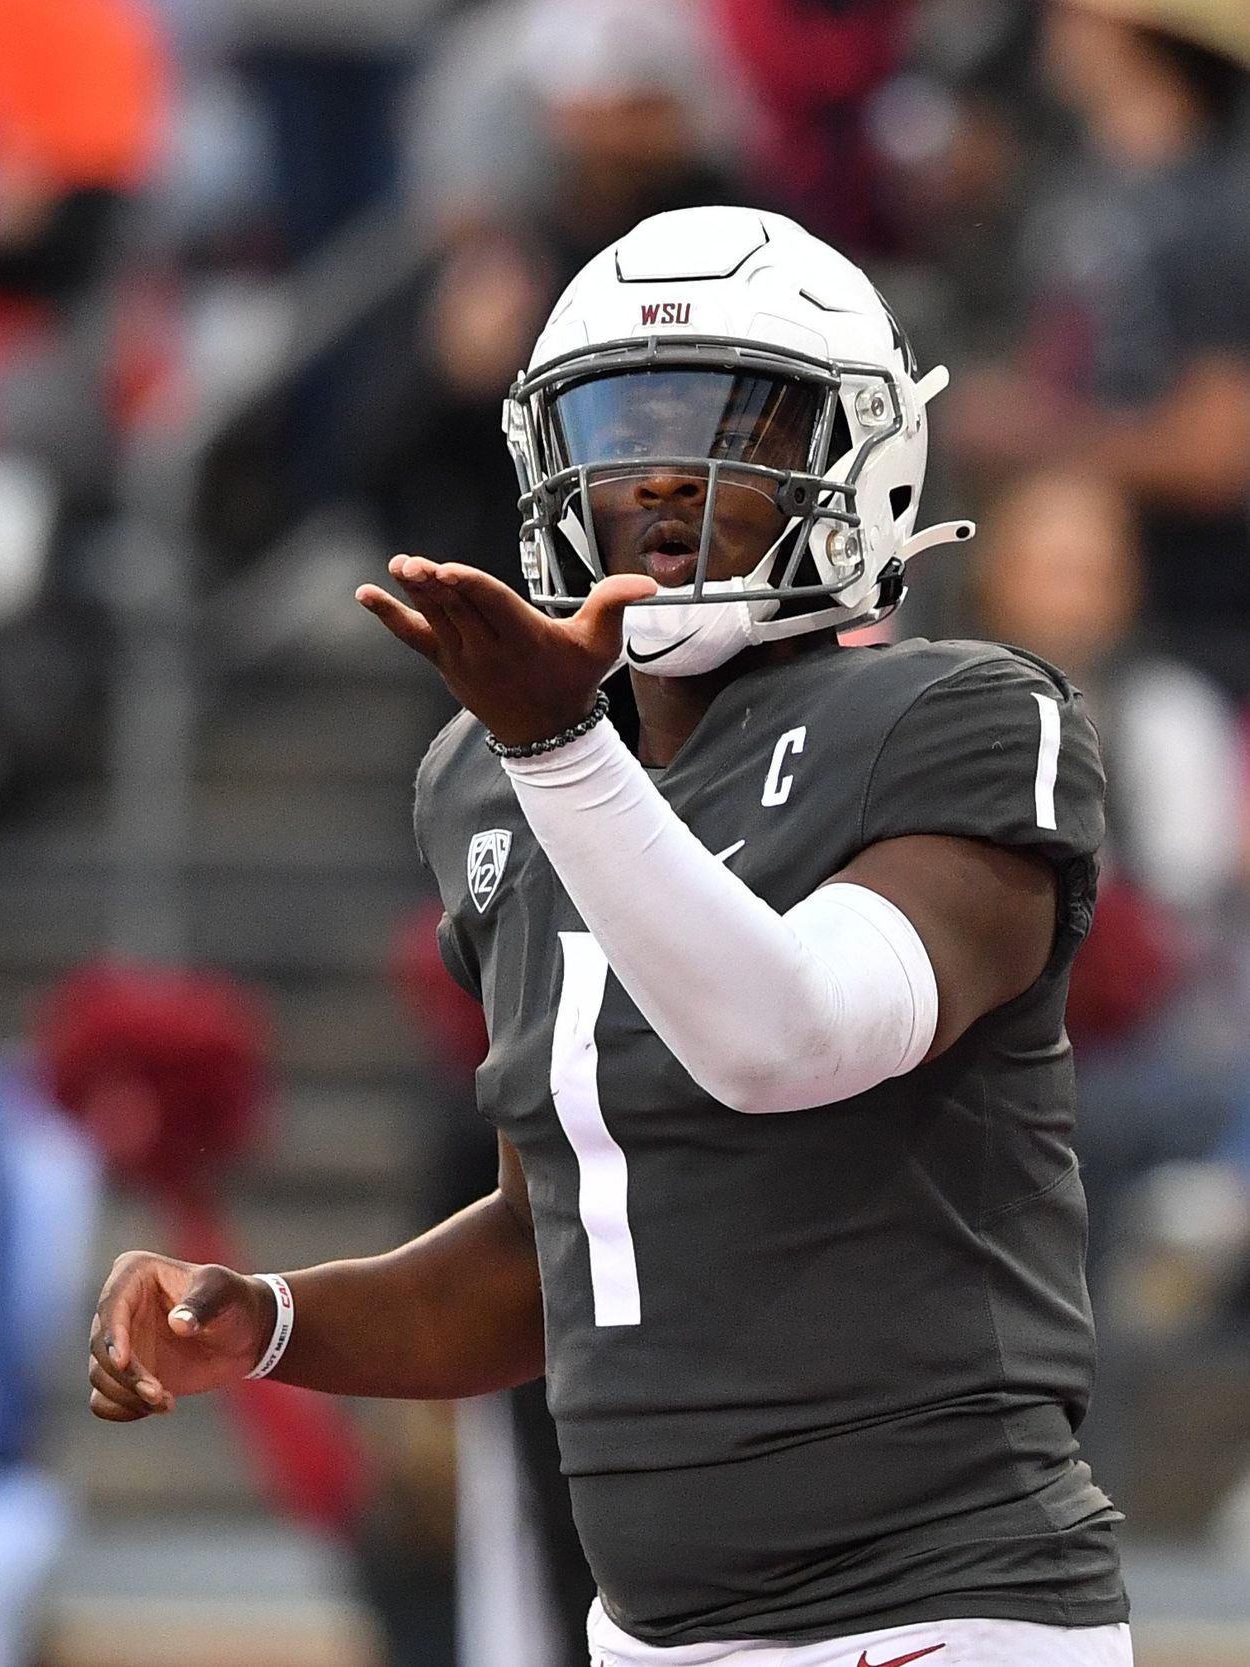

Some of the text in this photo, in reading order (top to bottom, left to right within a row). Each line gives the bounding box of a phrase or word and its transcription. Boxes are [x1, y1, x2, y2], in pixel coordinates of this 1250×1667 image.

[641, 303, 691, 325] WSU
[761, 726, 806, 807] C
[1030, 691, 1060, 830] 1
[471, 832, 510, 880] PAC
[474, 863, 495, 894] 12
[551, 932, 641, 1328] 1
[261, 1354, 276, 1371] NOT
